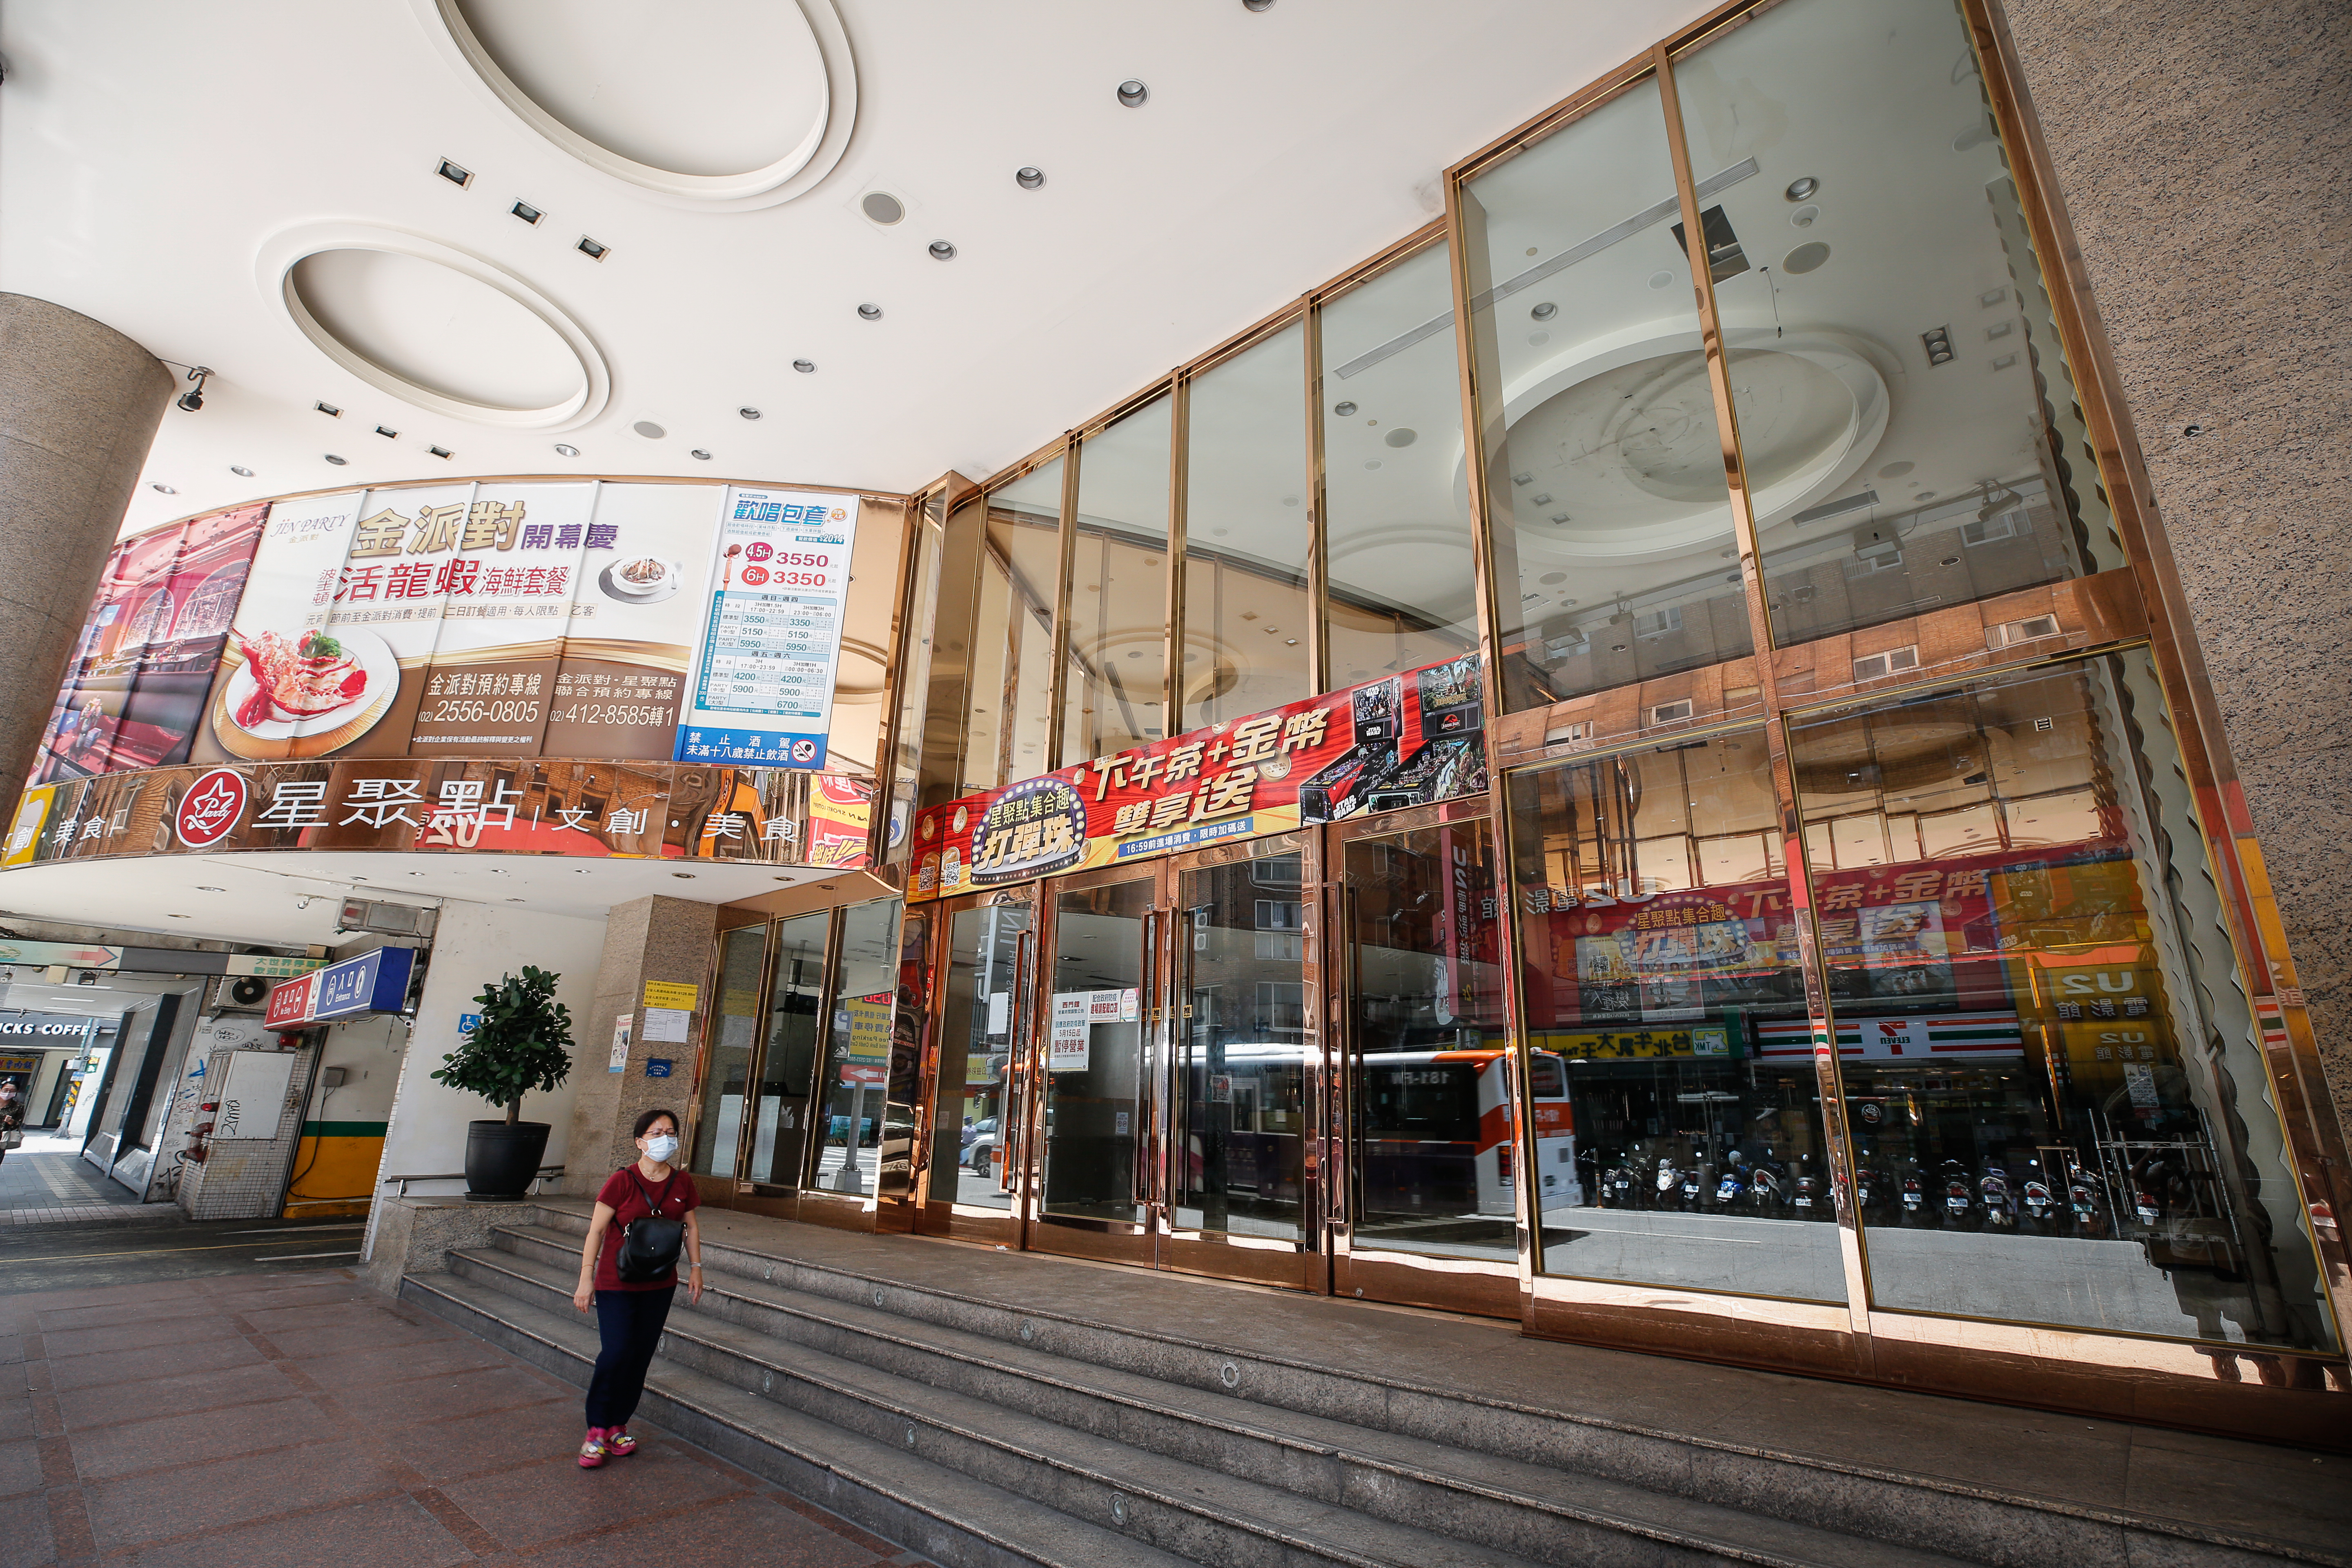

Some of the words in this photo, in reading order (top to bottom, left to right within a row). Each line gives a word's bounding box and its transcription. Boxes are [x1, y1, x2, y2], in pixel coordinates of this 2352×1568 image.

[733, 500, 827, 525] 歡唱包套
[301, 513, 351, 532] PARTY
[351, 500, 524, 558] 金派對
[521, 524, 619, 550] 開幕慶
[288, 533, 319, 543] 金派對
[820, 534, 844, 543] $2014
[747, 544, 771, 558] 4.5H
[776, 552, 829, 567] 3550
[312, 567, 337, 605] 波士頓
[332, 558, 481, 602] 活龍蝦
[479, 565, 570, 596] 海鮮套餐
[746, 568, 765, 582] 6H
[773, 571, 826, 586] 3350
[428, 673, 542, 696] 金派對預約專線
[555, 685, 673, 700] 聯合預約專線
[1365, 685, 1379, 693] STAR
[1434, 696, 1454, 707] JURASSIC
[1454, 693, 1467, 702] PARK
[418, 711, 433, 722] (02)
[433, 699, 540, 722] 2556-0805
[550, 710, 564, 722] 02)
[566, 703, 673, 727] 412-8585轉1
[689, 732, 791, 749] 禁止酒駕
[686, 744, 790, 762] 未滿十八歲禁止飲酒
[1093, 708, 1331, 801] 下午茶+金幣
[195, 797, 233, 818] Party
[252, 779, 523, 831] 星聚點
[989, 786, 1070, 829] 星聚點集合趣
[1111, 766, 1258, 838] 雙享送
[1333, 801, 1356, 820] WARS
[1336, 795, 1356, 811] STAR
[978, 813, 1075, 871] 打彈珠
[1637, 904, 1726, 929] 星聚點集合趣
[338, 970, 355, 991] 入口
[335, 992, 351, 1003] Entrance
[1092, 994, 1117, 1002] 配合政府防疫
[1090, 1002, 1118, 1014] 進場請配戴口罩
[1184, 1006, 1191, 1014] 推
[1055, 1020, 1085, 1028] 因應政府防疫政策
[1059, 1029, 1081, 1037] 5月15日起
[1054, 1039, 1085, 1053] 暫停營業
